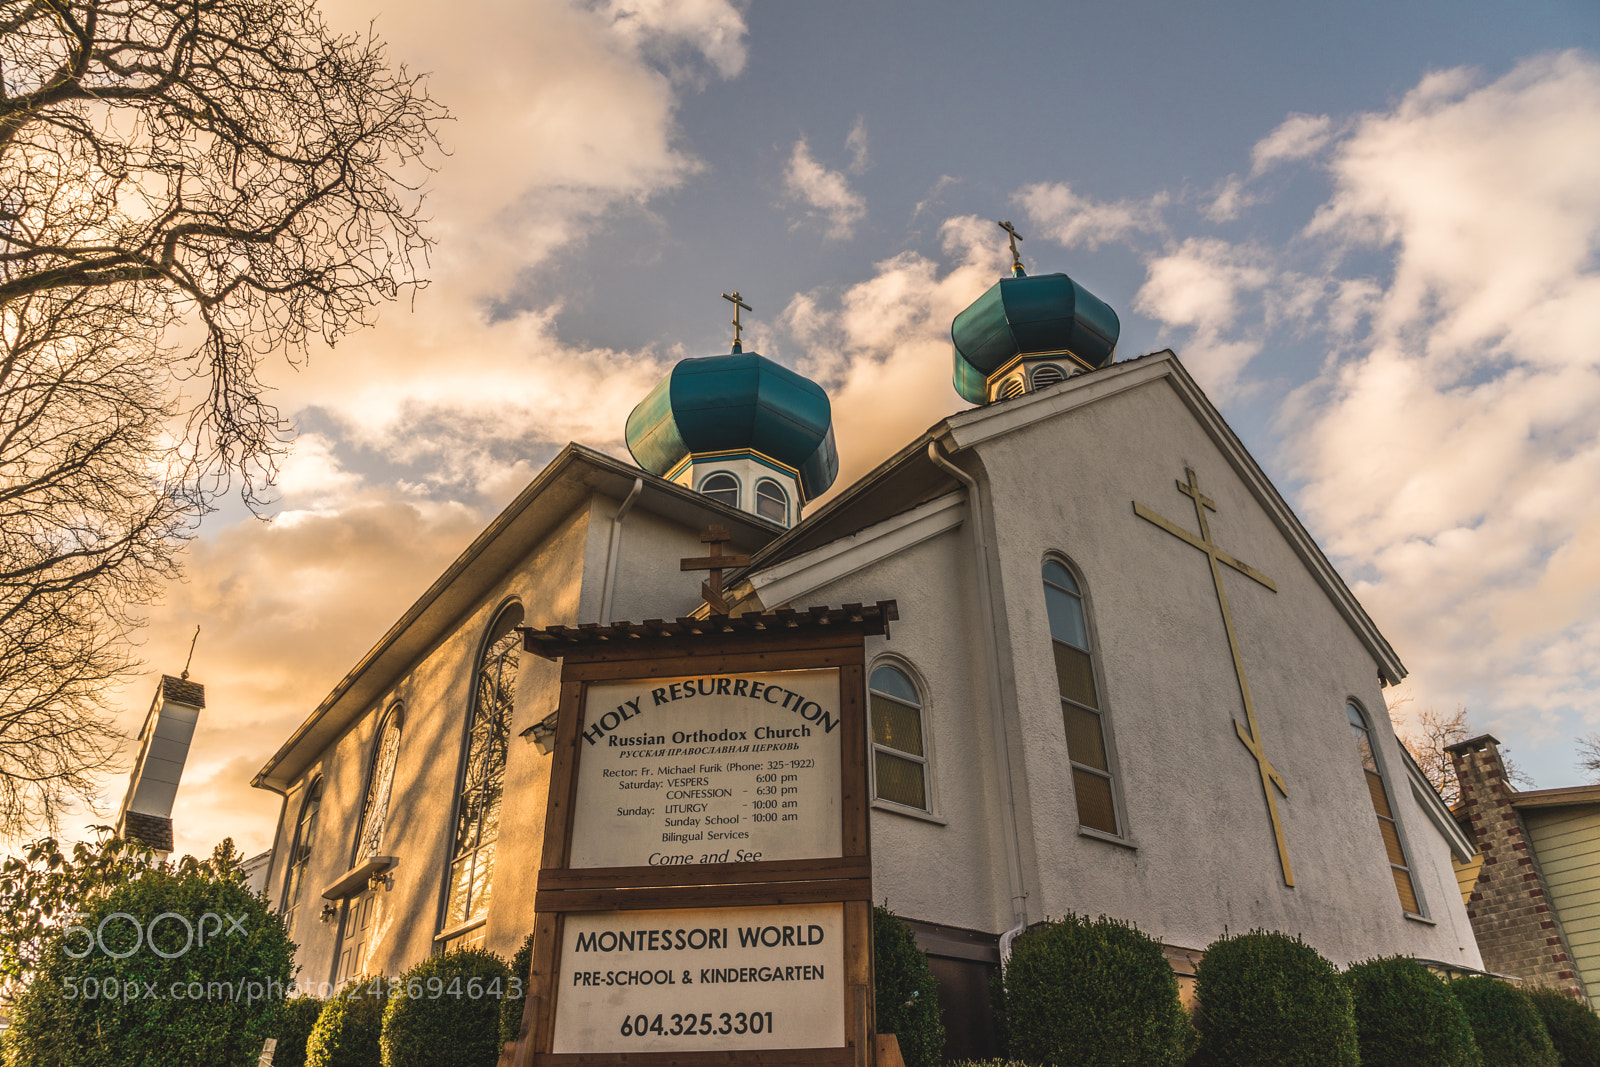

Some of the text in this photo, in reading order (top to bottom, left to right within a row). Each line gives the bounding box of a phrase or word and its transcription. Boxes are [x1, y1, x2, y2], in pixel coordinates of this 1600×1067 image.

[582, 677, 840, 746] HOLY RESURRECTION
[608, 724, 811, 747] Russian Orthodox Church
[619, 742, 800, 759] РУССКАЯ ПРАВОСЛАВНАЯ ЦЕРКОВЬ
[602, 758, 815, 778] Rector: Fr. Michael Furik (Phone: 325-1922)
[619, 773, 798, 790] Saturday: VESPERS 6:00 pm
[666, 788, 732, 799] CONFESSION
[756, 785, 777, 795] 6:30
[781, 786, 798, 796] pm
[617, 806, 655, 818] Sunday:
[665, 803, 708, 814] LITURGY
[752, 799, 778, 809] 10:00
[782, 800, 798, 808] am
[664, 817, 701, 828] Sunday
[705, 814, 739, 825] School
[752, 812, 778, 822] 10:00
[782, 813, 798, 821] am
[662, 830, 750, 844] Bilingual Services
[648, 849, 762, 866] Come and See
[575, 925, 824, 952] MONTESSORI WORLD
[573, 965, 825, 986] PRE-SCHOOL & KINDERGARTEN
[620, 1011, 773, 1037] 604.325.3301
